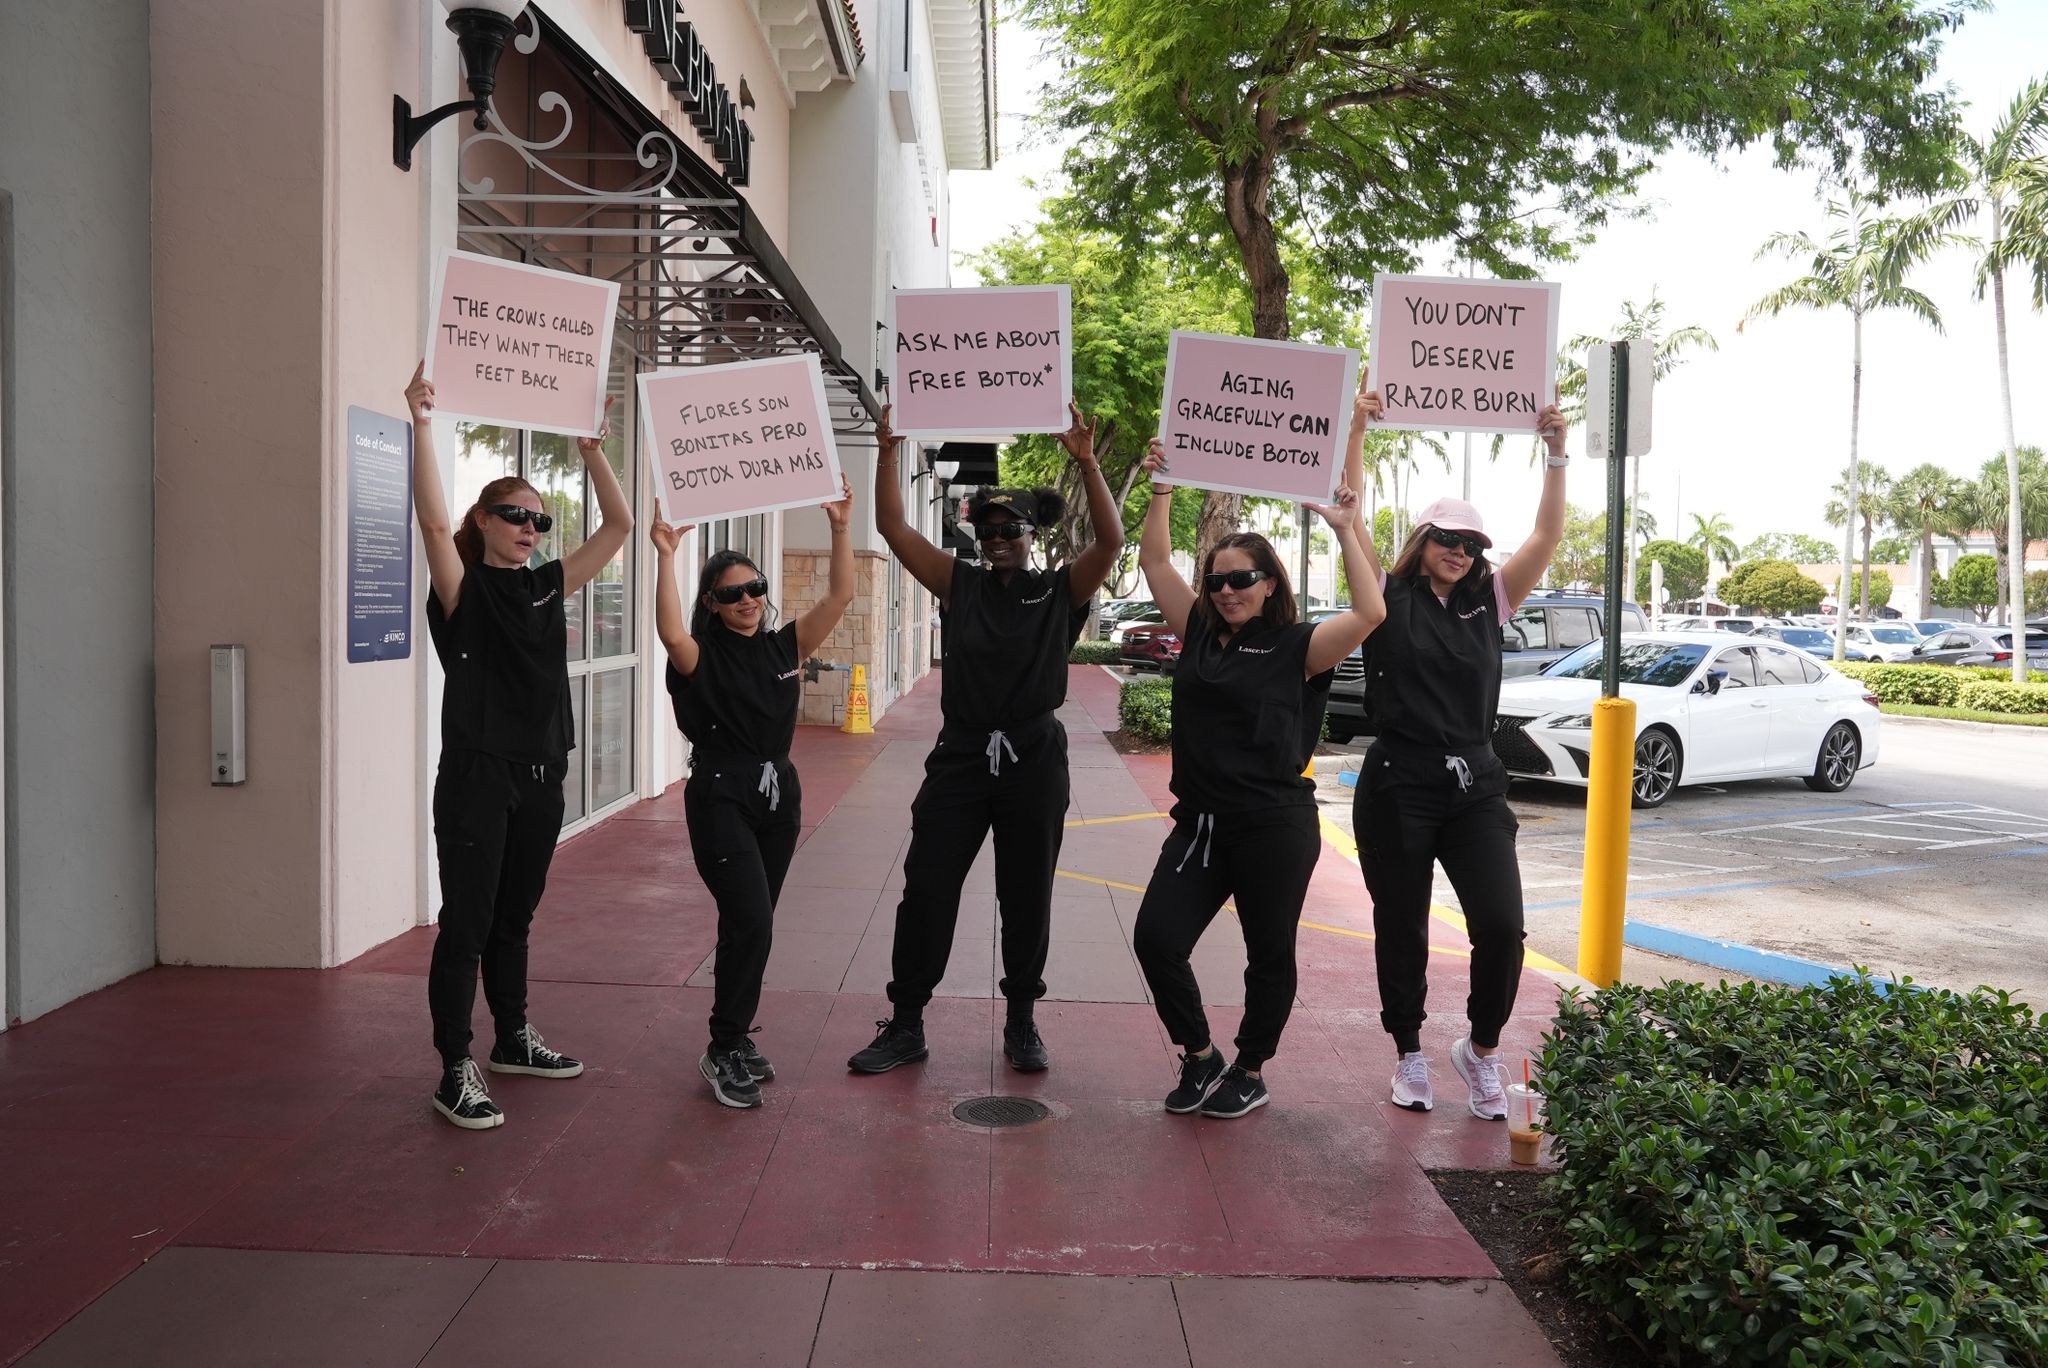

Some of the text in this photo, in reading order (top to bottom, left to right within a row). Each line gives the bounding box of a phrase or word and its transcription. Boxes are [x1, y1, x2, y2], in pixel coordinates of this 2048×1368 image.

[669, 22, 755, 187] BRYANT
[453, 296, 594, 336] THE CROWS CALLED
[1405, 297, 1525, 326] YOU DON'T
[442, 324, 595, 367] THEY WANT THEIR
[896, 330, 1060, 353] ASK ME ABOUT
[1411, 340, 1514, 370] DESERVE
[475, 364, 559, 391] FEET BACK
[909, 370, 966, 394] FREE
[1220, 371, 1294, 400] AGING
[680, 396, 789, 424] FLORES SON
[1386, 383, 1537, 413] RAZOR BURN
[1177, 398, 1330, 436] GRACEFULLY CAN
[355, 434, 402, 456] Code of Conduct
[671, 422, 807, 457] BONITAS PERO
[1174, 433, 1320, 467] INCLUDE BOTOX
[669, 447, 824, 490] BOTOX DURA MÁS
[389, 632, 406, 642] KIMCO
